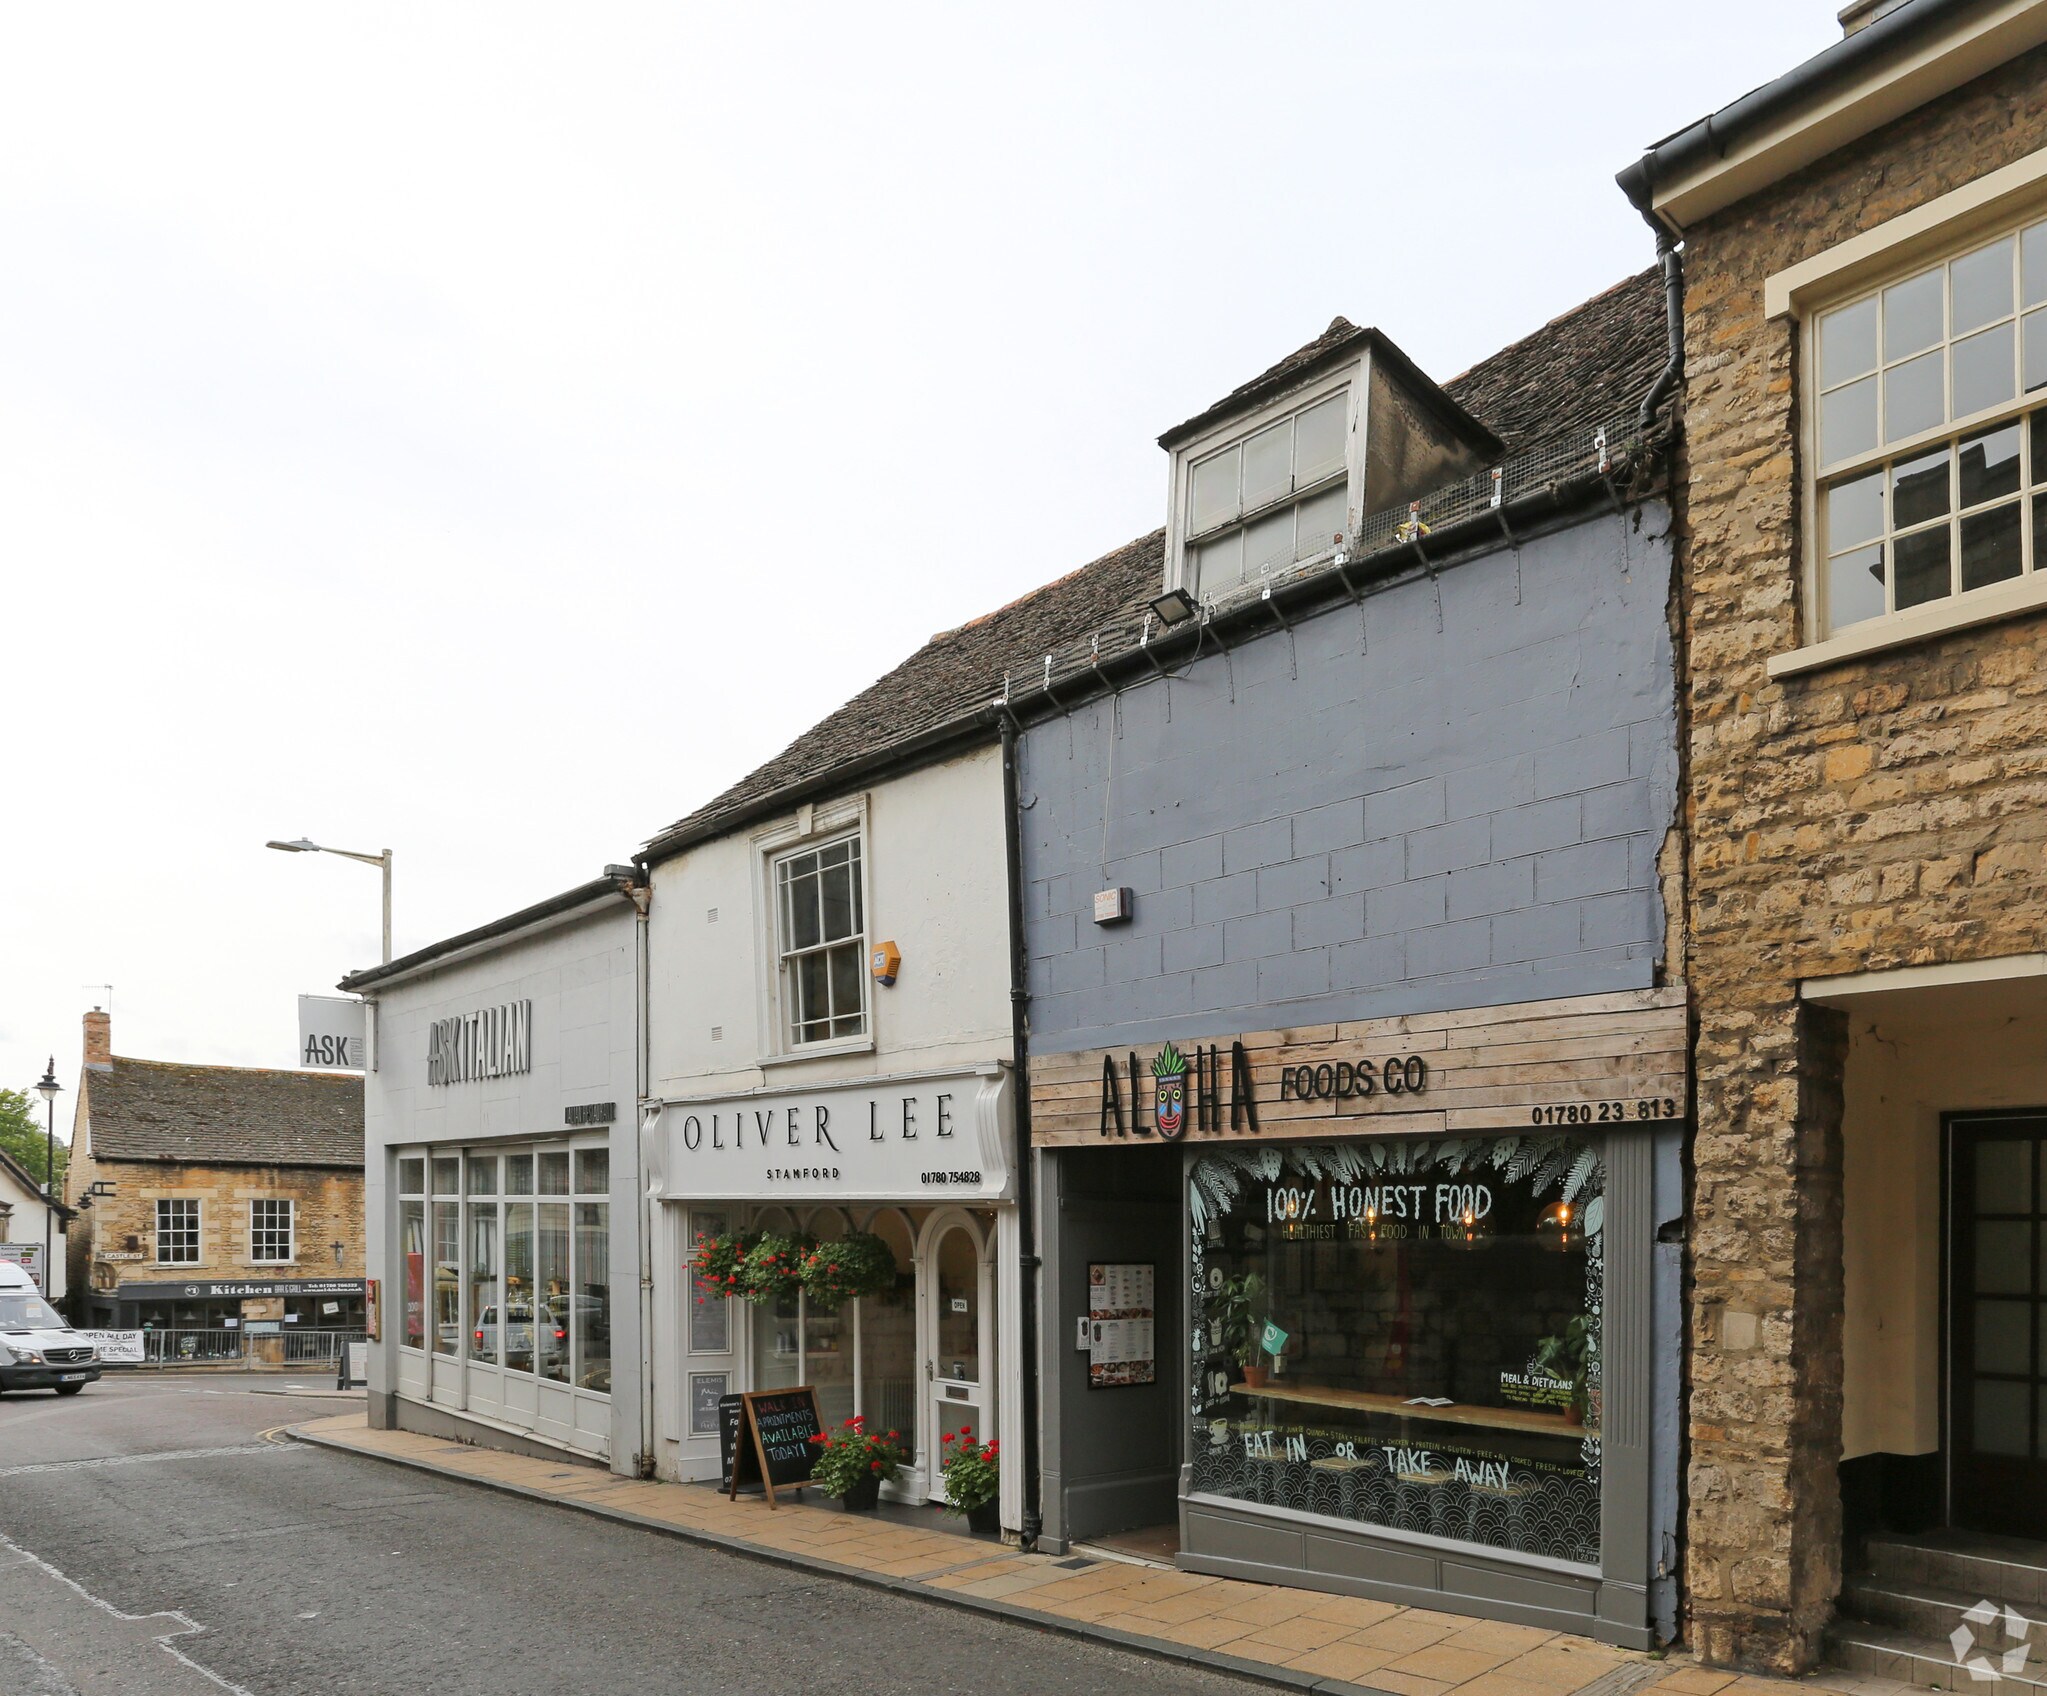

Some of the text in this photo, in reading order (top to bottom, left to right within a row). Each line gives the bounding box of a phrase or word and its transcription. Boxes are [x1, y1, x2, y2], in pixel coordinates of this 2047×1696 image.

[305, 1034, 349, 1065] ASK
[427, 999, 532, 1086] ASK ITALIAN
[1281, 1059, 1374, 1101] FOODS
[1383, 1055, 1427, 1094] CO
[684, 1093, 954, 1152] OLIVER LEE
[1531, 1104, 1592, 1125] 01780
[766, 1167, 840, 1180] STAMFORD
[921, 1171, 980, 1184] 01780 754828
[1267, 1184, 1493, 1223] 100% HONEST FOOD
[1282, 1224, 1467, 1241] HEALTHIEST FAST FOOD IN TOWN
[210, 1285, 272, 1295] Kitchen
[274, 1284, 285, 1294] BAR
[289, 1284, 302, 1293] GRILL
[954, 1301, 965, 1309] OPEN
[122, 1332, 137, 1340] DAY
[1500, 1372, 1522, 1384] MEAL
[1522, 1374, 1529, 1385] &
[1548, 1379, 1573, 1390] PLANS
[757, 1408, 814, 1428] APPOINTMENTS
[761, 1424, 815, 1445] AVAILABLE
[766, 1442, 807, 1461] TODAY!
[1244, 1430, 1509, 1491] EAT IN OR TAKE AWAY
[1306, 1428, 1326, 1436] QUINOA
[1331, 1431, 1349, 1440] STEAK
[1354, 1435, 1378, 1445] FALAFEL
[1387, 1438, 1409, 1446] CHICKEN
[1415, 1441, 1440, 1451] PROTEIN
[1498, 1453, 1507, 1461] ALL
[1511, 1456, 1532, 1467] COOKED
[1535, 1461, 1556, 1472] FRESH
[1562, 1467, 1577, 1476] LOVE
